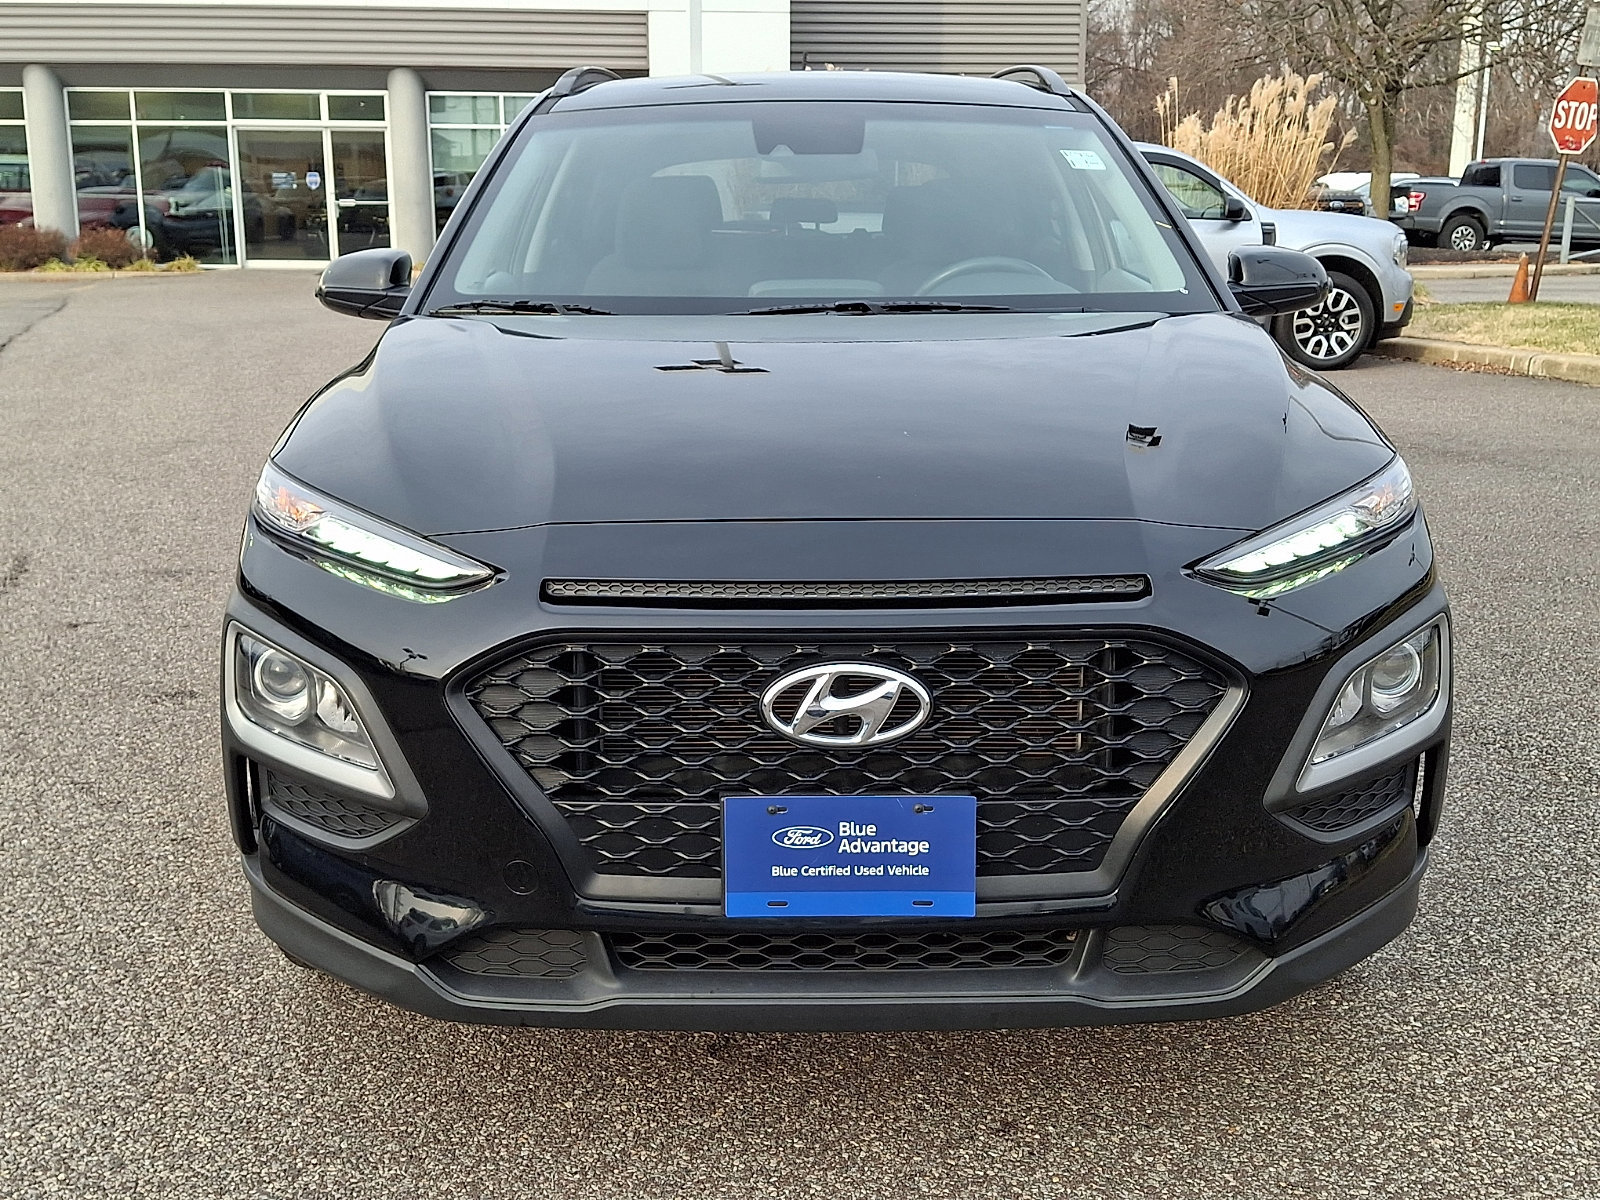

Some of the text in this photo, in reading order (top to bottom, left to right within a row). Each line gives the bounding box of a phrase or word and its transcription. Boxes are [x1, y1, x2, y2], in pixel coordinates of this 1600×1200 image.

[1554, 100, 1597, 131] STOP
[839, 821, 877, 836] Blue
[783, 829, 822, 845] Ford
[838, 838, 929, 855] Advantage
[771, 865, 929, 876] Blue Certified Used Vehicle
